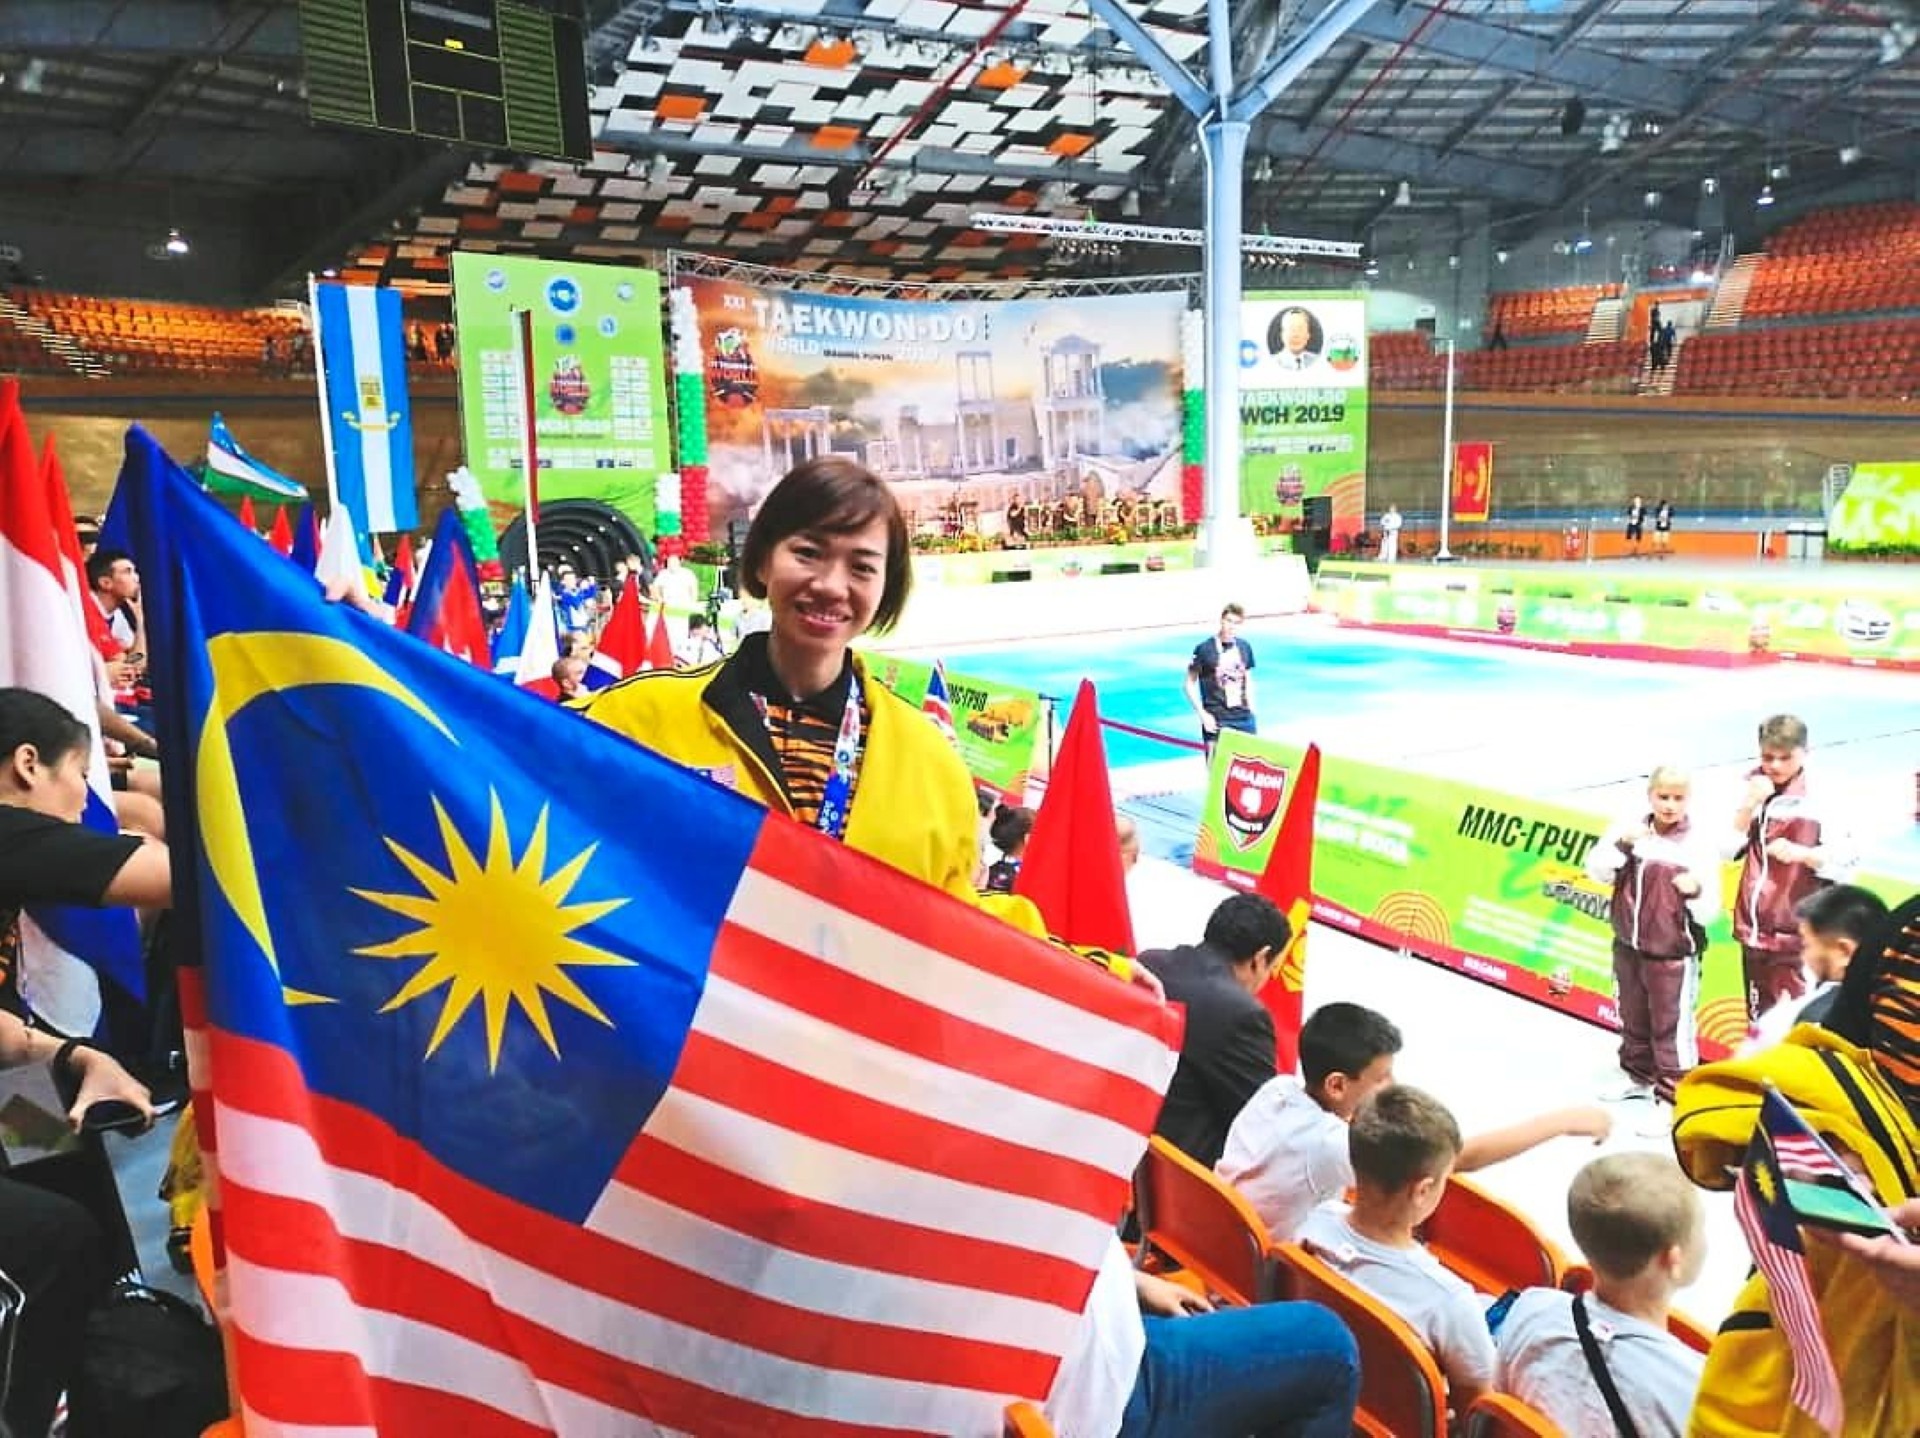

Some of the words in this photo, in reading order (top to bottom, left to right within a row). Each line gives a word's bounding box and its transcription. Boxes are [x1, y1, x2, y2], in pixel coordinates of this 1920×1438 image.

[752, 297, 978, 341] TAEKWON-DO
[1240, 405, 1289, 425] WCH
[1294, 403, 1345, 423] 2019
